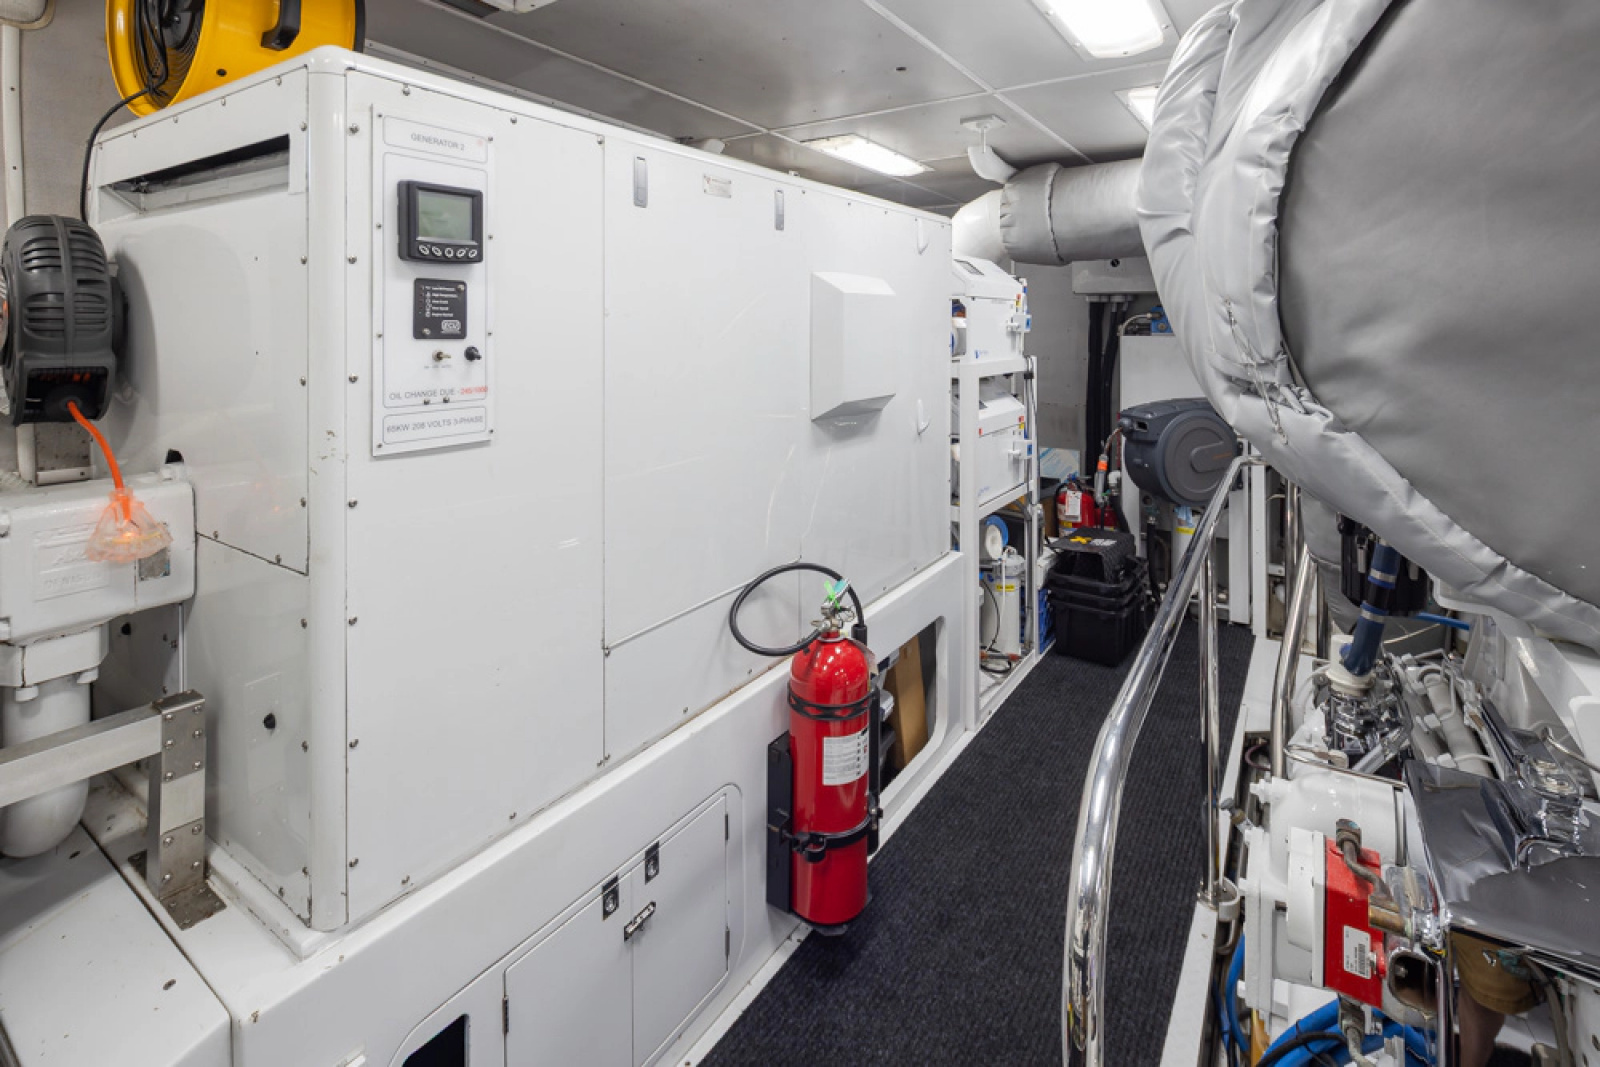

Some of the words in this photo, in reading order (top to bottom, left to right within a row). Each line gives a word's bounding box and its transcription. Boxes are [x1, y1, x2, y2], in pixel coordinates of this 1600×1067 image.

[410, 132, 459, 149] GENERATOR
[460, 143, 465, 151] 2
[389, 392, 402, 401] OIL
[404, 389, 437, 399] CHANGE
[440, 388, 455, 397] DUE
[412, 422, 425, 431] 208
[427, 419, 452, 428] VOLTS
